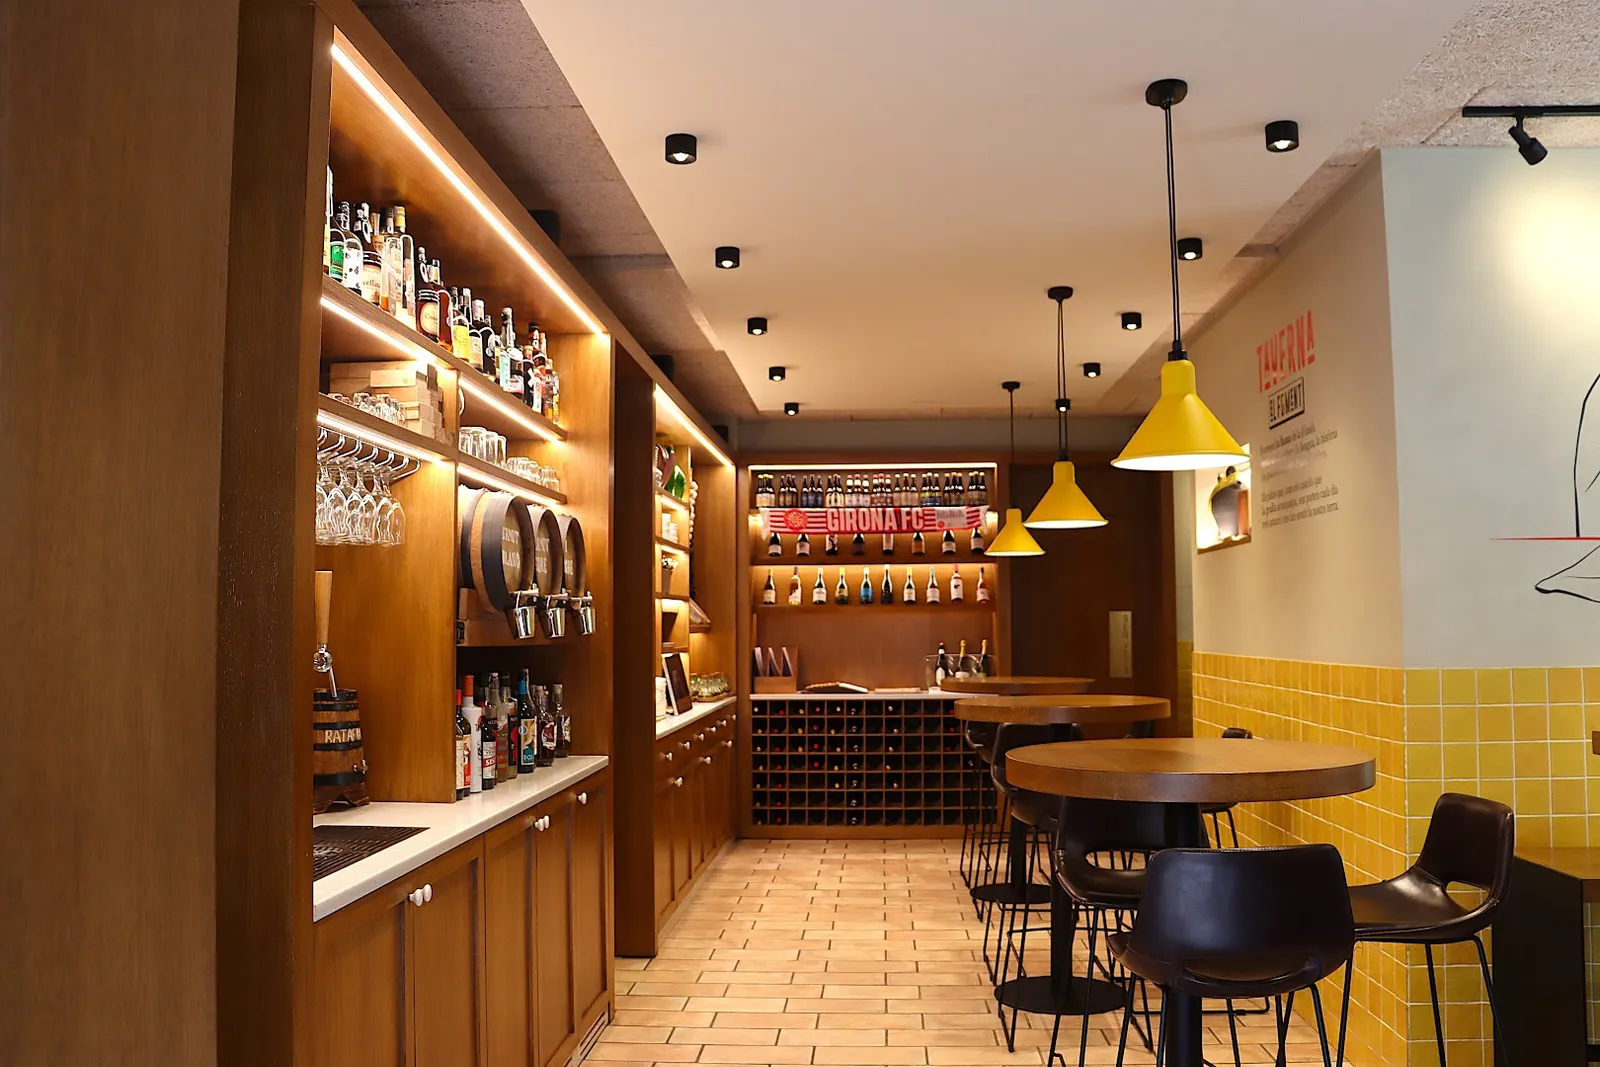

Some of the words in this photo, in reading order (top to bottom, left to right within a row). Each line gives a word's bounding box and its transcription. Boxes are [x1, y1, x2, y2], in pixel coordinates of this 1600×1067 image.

[1256, 309, 1315, 394] TAVERNA
[827, 508, 899, 531] GIRONA
[901, 508, 925, 530] FC
